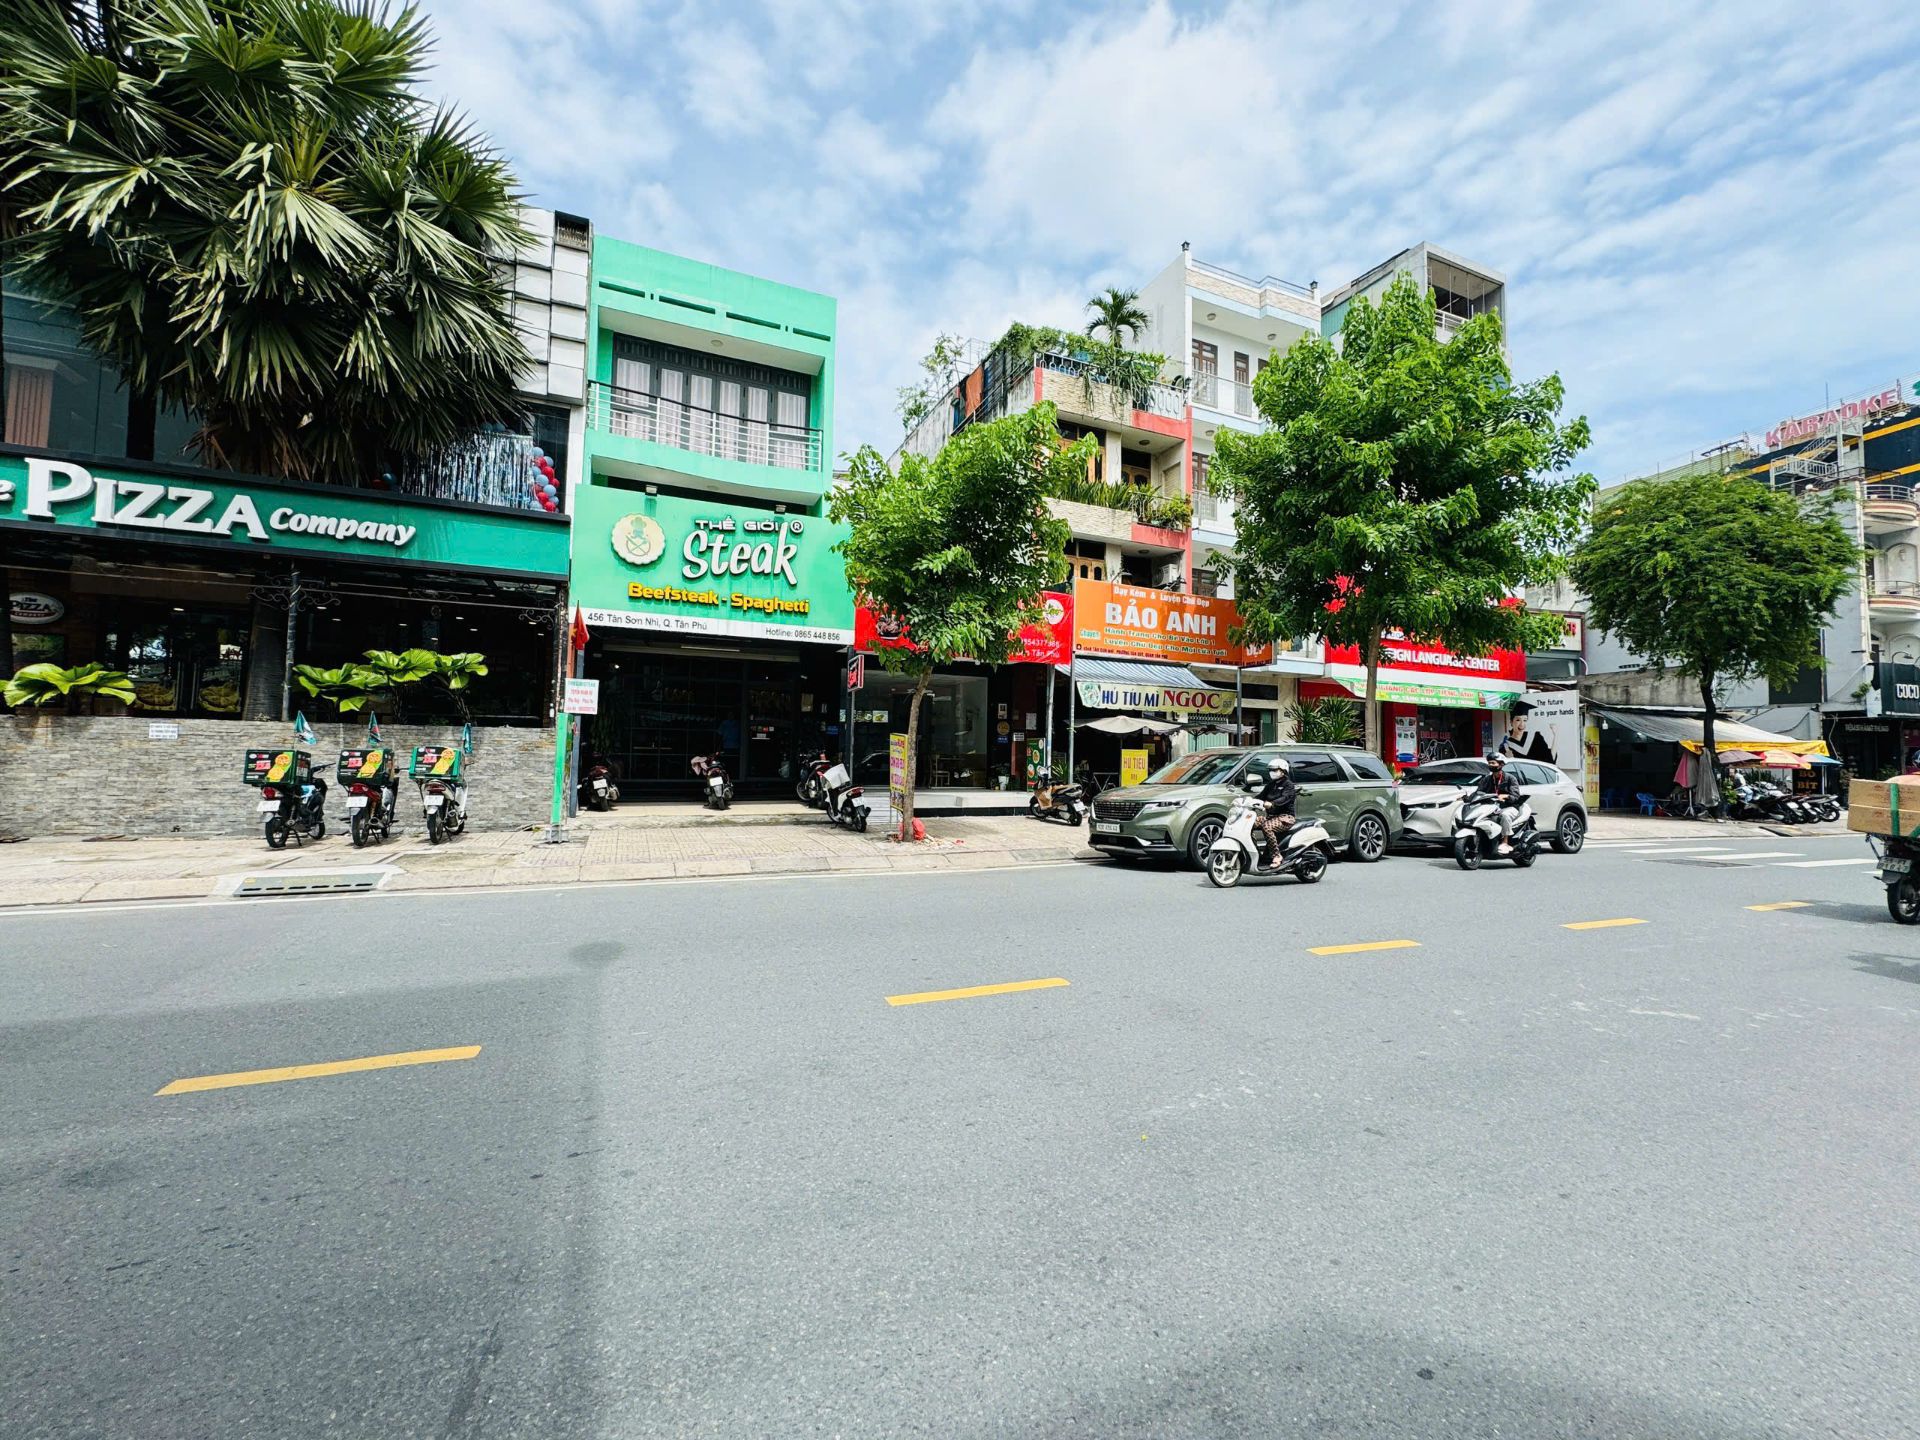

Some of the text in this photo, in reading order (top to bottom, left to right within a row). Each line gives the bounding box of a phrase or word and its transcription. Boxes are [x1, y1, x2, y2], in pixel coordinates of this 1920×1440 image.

[1765, 390, 1898, 447] KARAOKE
[22, 457, 270, 540] PIZZA
[269, 507, 416, 547] Company
[682, 522, 798, 586] Steak
[628, 582, 719, 605] Beefsteak
[730, 592, 810, 614] Spaghetti
[1150, 591, 1156, 600] &
[588, 612, 604, 622] 456
[607, 613, 622, 623] Tân
[625, 615, 642, 625] Sơn
[663, 619, 673, 628] Q.
[675, 619, 689, 629] Tân
[692, 621, 707, 630] Phú
[1105, 599, 1216, 636] BẢO ANH
[766, 627, 840, 641] Hotline: 0865 448 856
[1465, 656, 1500, 672] CENTER
[1896, 683, 1920, 699] COCO
[1162, 690, 1220, 713] NGỌC
[1547, 698, 1564, 706] future
[1559, 708, 1575, 716] hands
